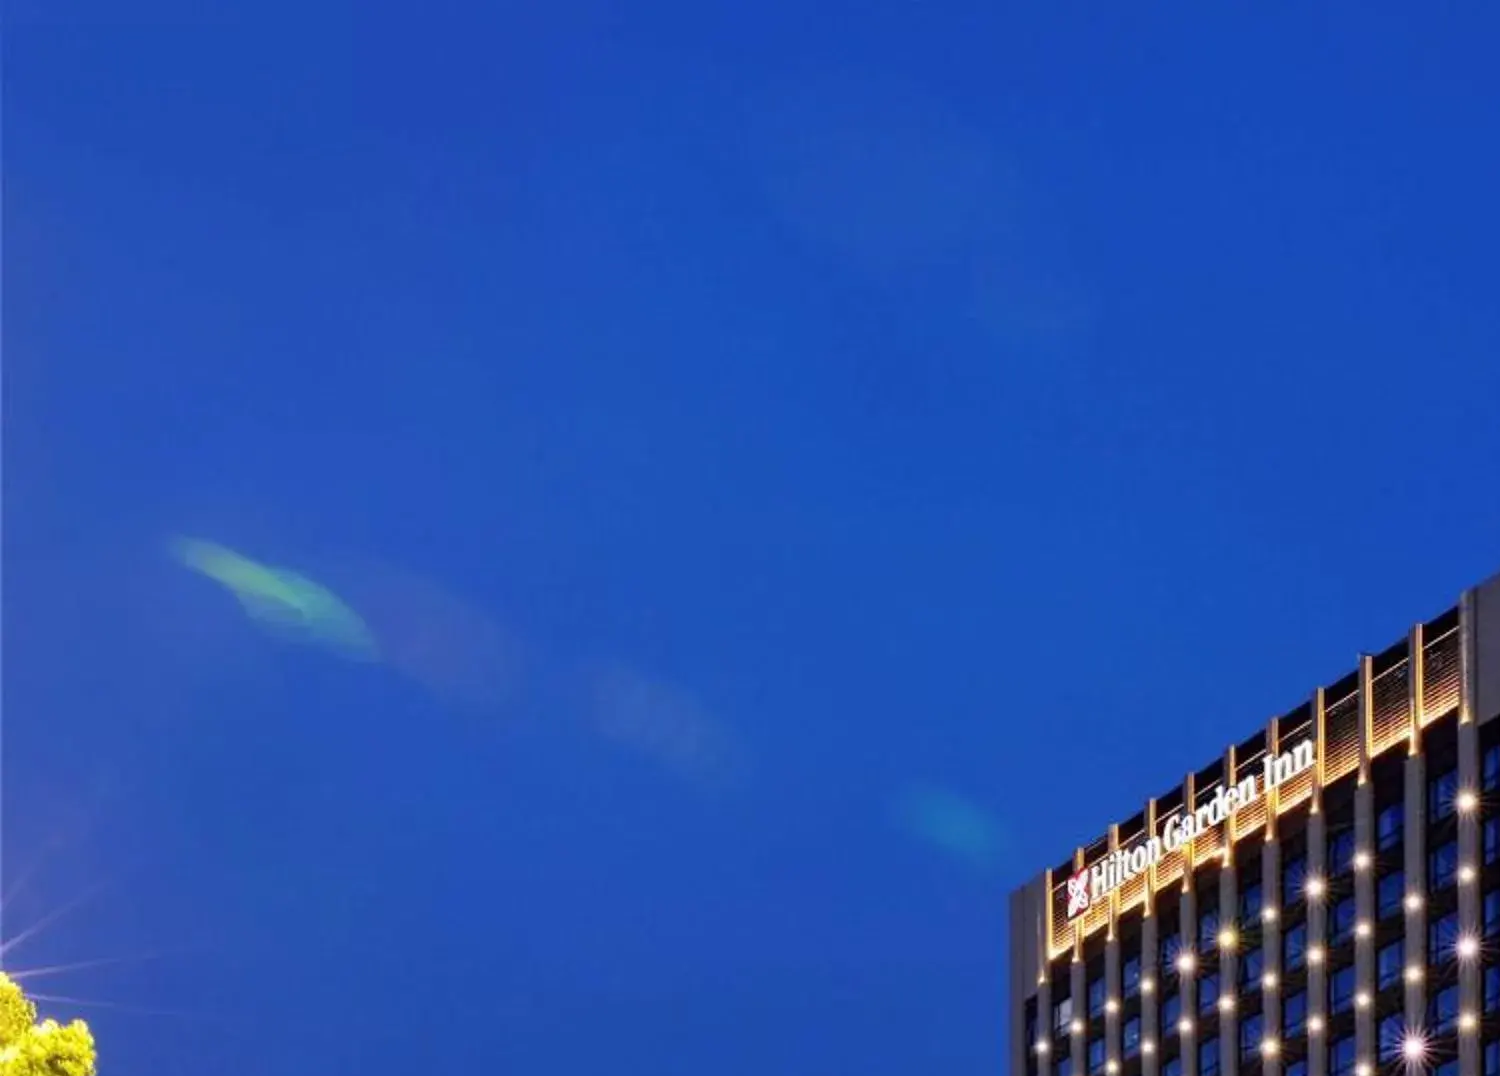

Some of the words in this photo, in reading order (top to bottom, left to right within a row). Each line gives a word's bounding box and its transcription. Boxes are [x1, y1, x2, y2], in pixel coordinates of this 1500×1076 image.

[1090, 833, 1161, 900] Hilton
[1162, 773, 1257, 850] Garden
[1262, 739, 1314, 790] Inn
